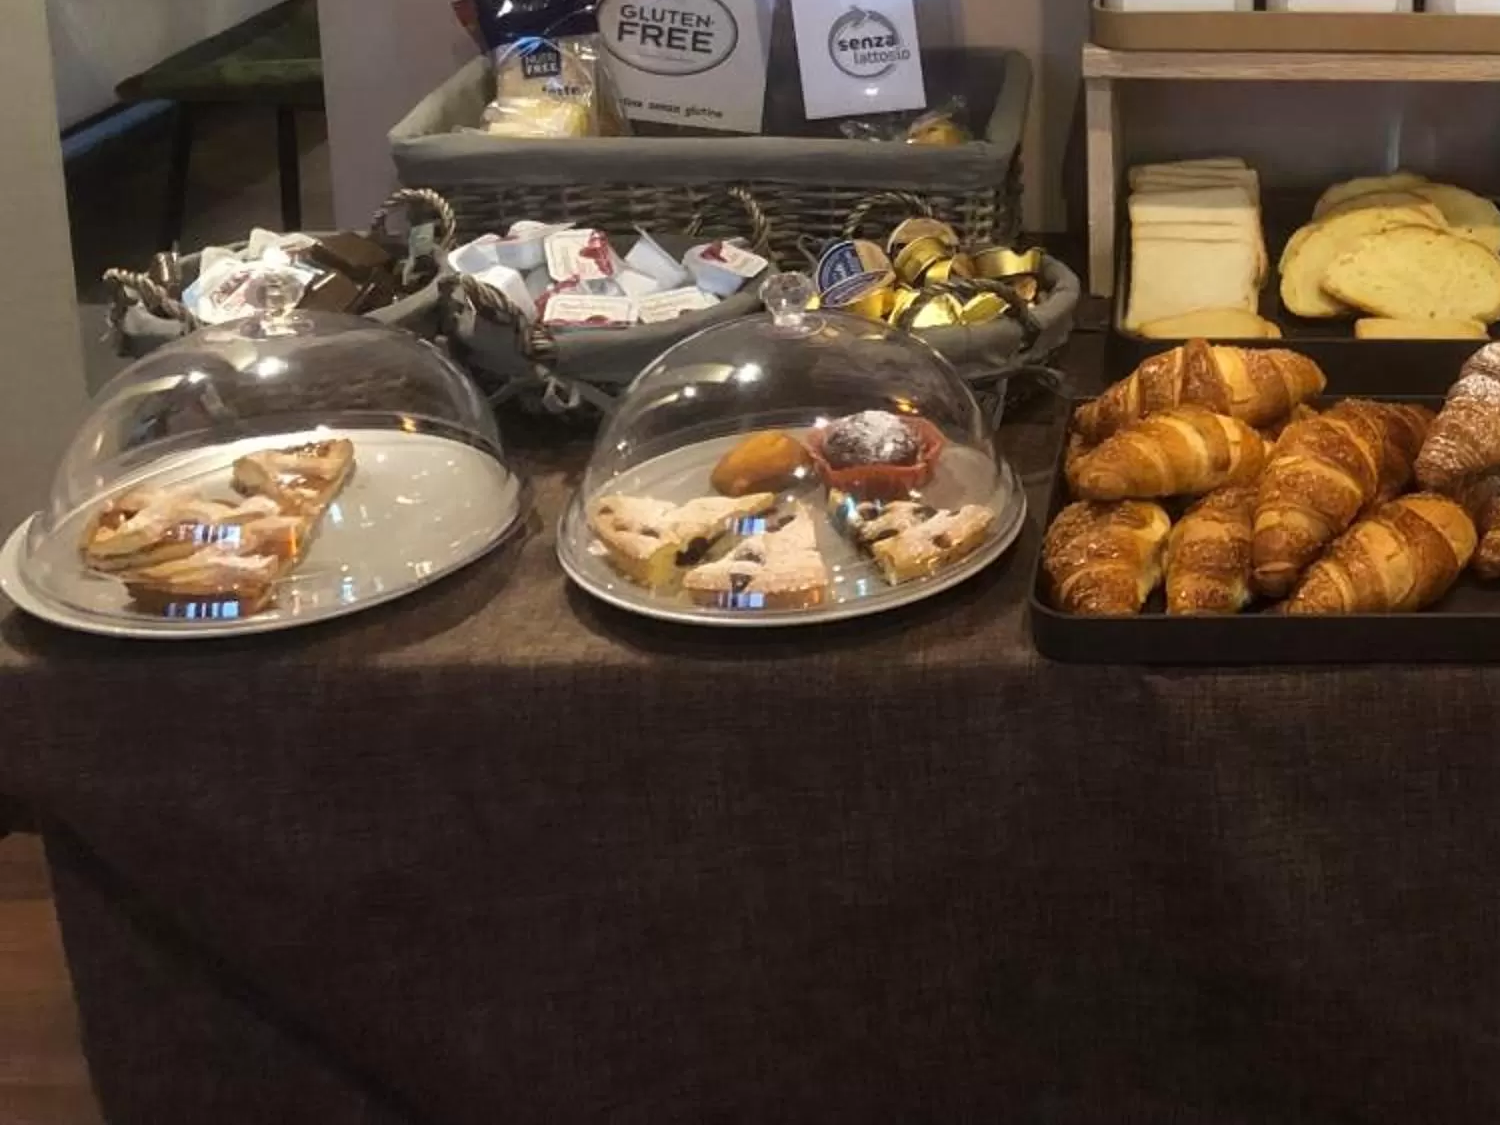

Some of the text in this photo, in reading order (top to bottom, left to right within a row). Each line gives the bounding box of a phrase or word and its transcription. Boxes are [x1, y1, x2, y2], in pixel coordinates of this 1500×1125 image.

[620, 3, 712, 28] GLUTEN
[617, 20, 714, 54] FREE
[838, 34, 897, 52] senza
[853, 48, 911, 64] lattosio
[526, 62, 559, 75] FREE
[685, 105, 724, 119] glutine
